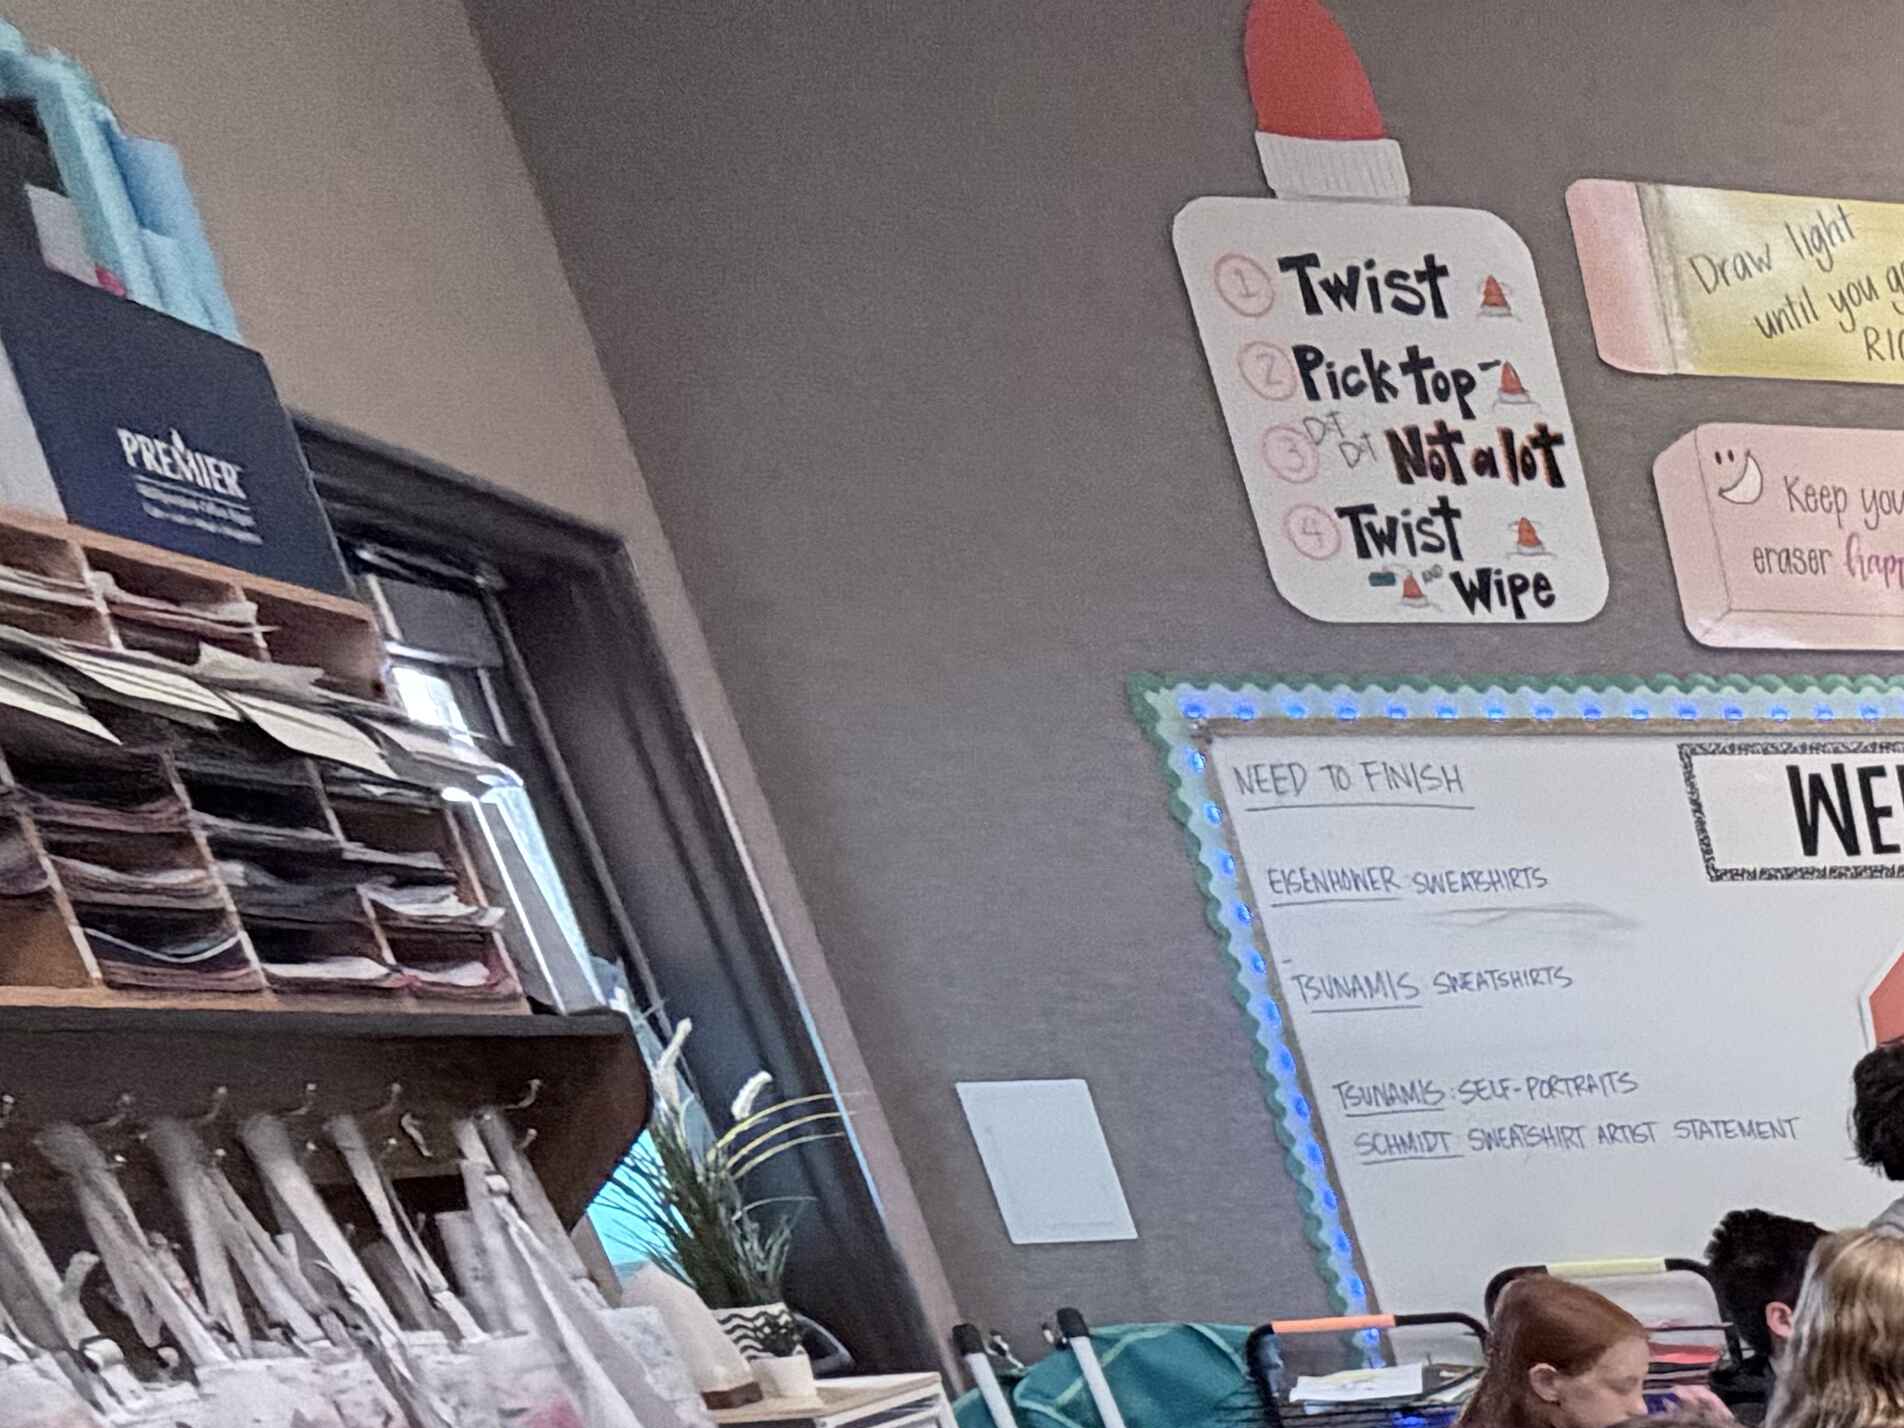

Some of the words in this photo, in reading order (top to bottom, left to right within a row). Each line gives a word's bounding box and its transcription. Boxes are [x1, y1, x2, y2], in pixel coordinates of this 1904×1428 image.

[1688, 243, 1772, 295] Draw
[1789, 203, 1856, 272] light
[1278, 253, 1448, 319] Twist
[1753, 287, 1819, 341] until
[1828, 279, 1879, 333] you
[1292, 344, 1398, 402] Pick
[1400, 344, 1477, 420] top
[117, 427, 247, 499] PREMIER
[1385, 419, 1466, 487] Not
[1472, 440, 1497, 476] a
[1496, 422, 1566, 488] lot
[1335, 496, 1464, 561] Twist
[1784, 474, 1849, 529] Keep
[1752, 541, 1833, 575] eraser
[1449, 568, 1555, 620] Wipe
[1233, 763, 1309, 796] NEED
[1327, 765, 1353, 791] TO
[1364, 763, 1465, 793] FINISH
[1268, 866, 1402, 895] EISENHOWER
[1411, 865, 1549, 896] SWEATSHIRTS
[1290, 971, 1420, 1005] TSUNAMIS
[1432, 965, 1573, 995] SWEATSHIRTS
[1457, 1071, 1640, 1105] SELF-PORTRAITS
[1355, 1131, 1453, 1156] SCHMIDT
[1468, 1123, 1588, 1152] SWEATSHIRT
[1597, 1121, 1657, 1146] ARTIST
[1673, 1117, 1800, 1143] STATEMENT
